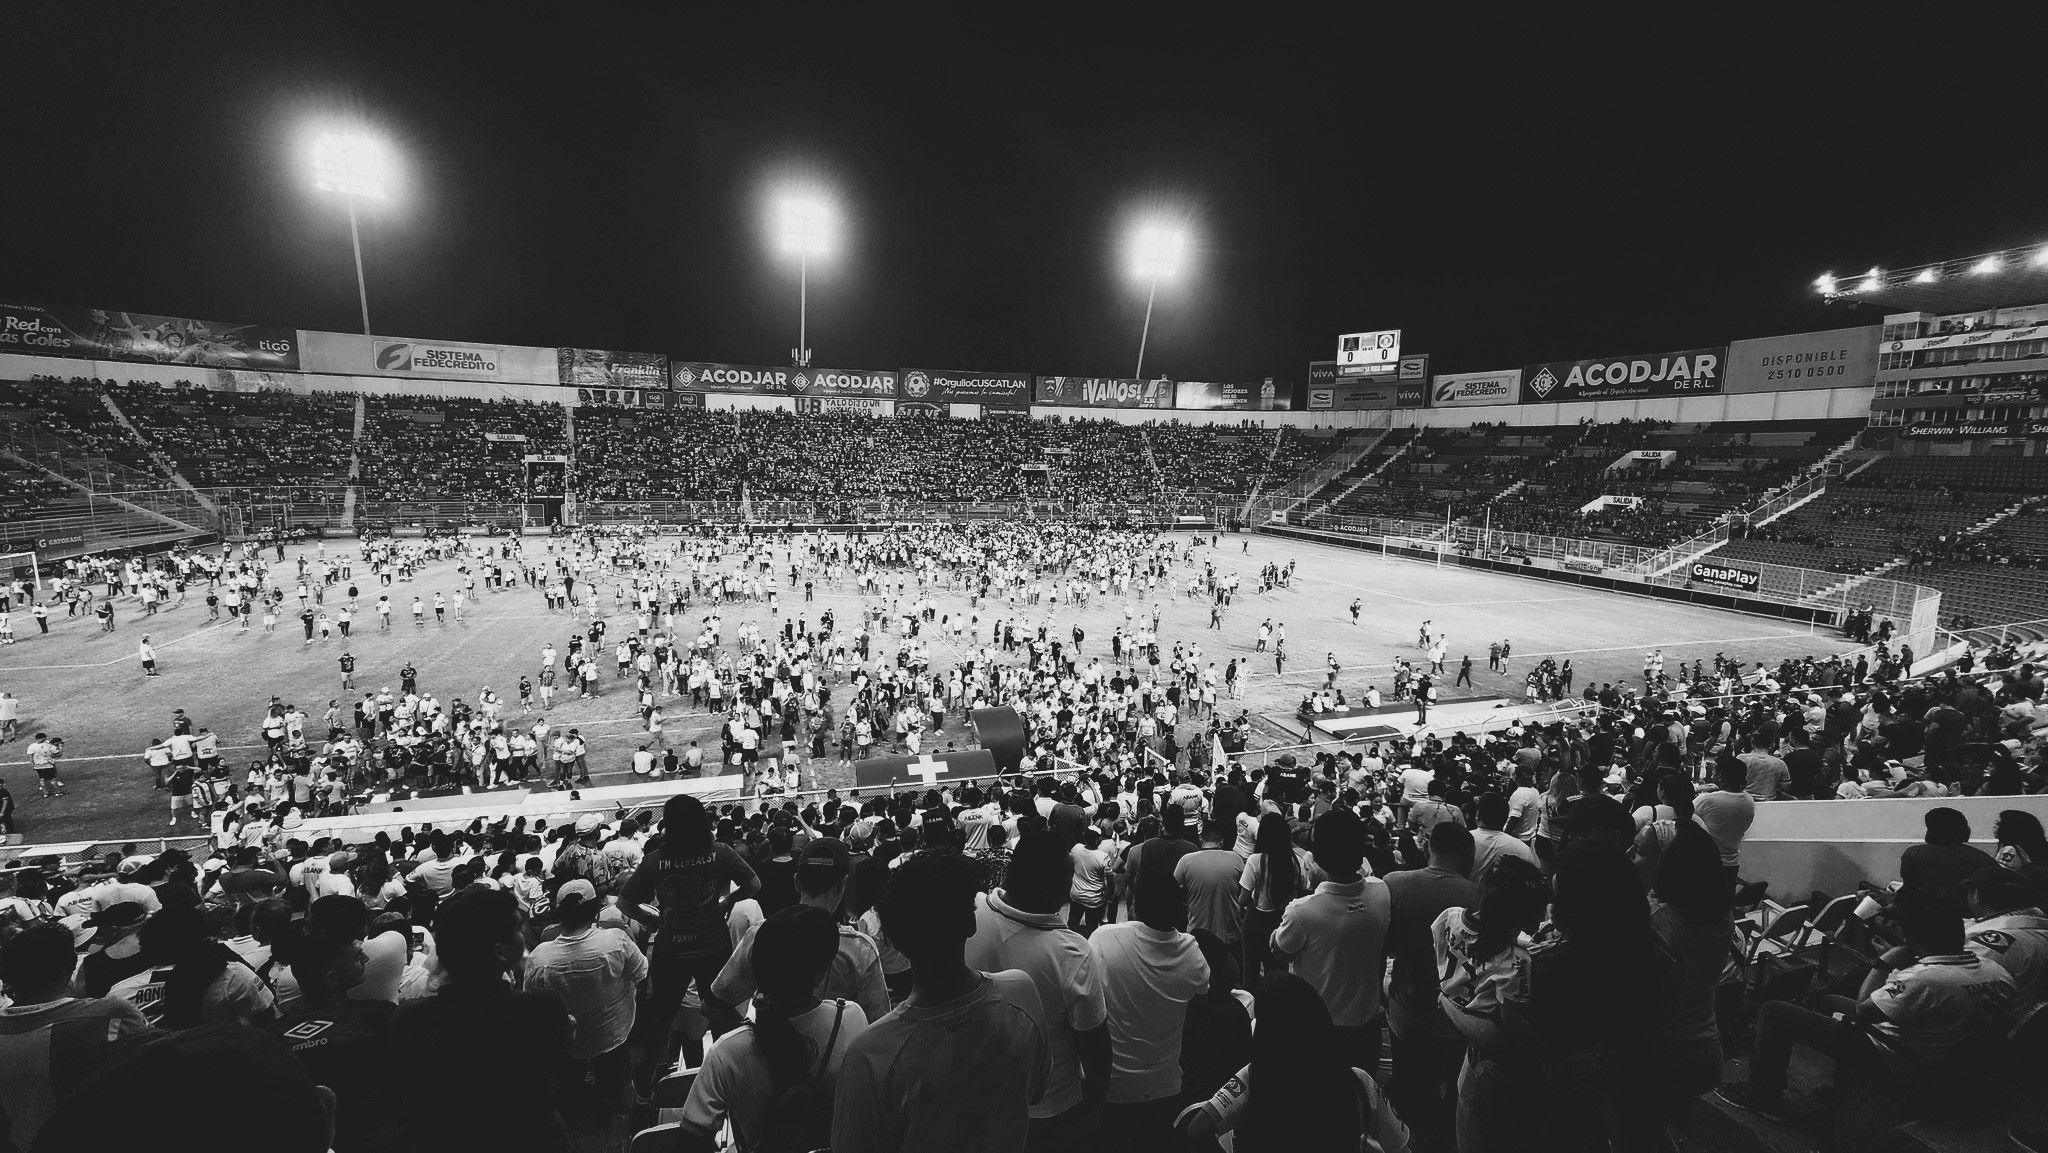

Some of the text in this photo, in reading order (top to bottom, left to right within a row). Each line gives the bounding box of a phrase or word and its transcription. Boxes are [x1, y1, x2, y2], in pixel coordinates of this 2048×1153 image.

[5, 316, 40, 331] Red
[0, 328, 71, 348] ás Goles
[426, 350, 483, 361] SISTEMA
[1348, 349, 1388, 363] 0 0
[1762, 350, 1847, 366] DISPONIBLE
[413, 358, 495, 370] FEDECREDITO
[610, 363, 661, 376] Franklin
[700, 369, 787, 385] ACODJAR
[1563, 354, 1717, 388] ACODJAR
[1767, 365, 1845, 380] 2510 0500
[813, 374, 894, 389] ACODJAR
[933, 377, 1026, 388] #OrgulloCUSCATLAN
[1464, 381, 1500, 391] SISTEMA
[1674, 379, 1715, 389] DE R.L.
[1083, 378, 1142, 404] ¡VAMOS!
[1456, 387, 1507, 397] FEDECREDITO
[1909, 425, 2008, 435] SHERWIN-WILLIAMS
[1339, 524, 1369, 534] ACODJAR
[49, 536, 83, 546] GATORADE
[1692, 563, 1758, 585] GanaPlay
[659, 860, 671, 870] I'M
